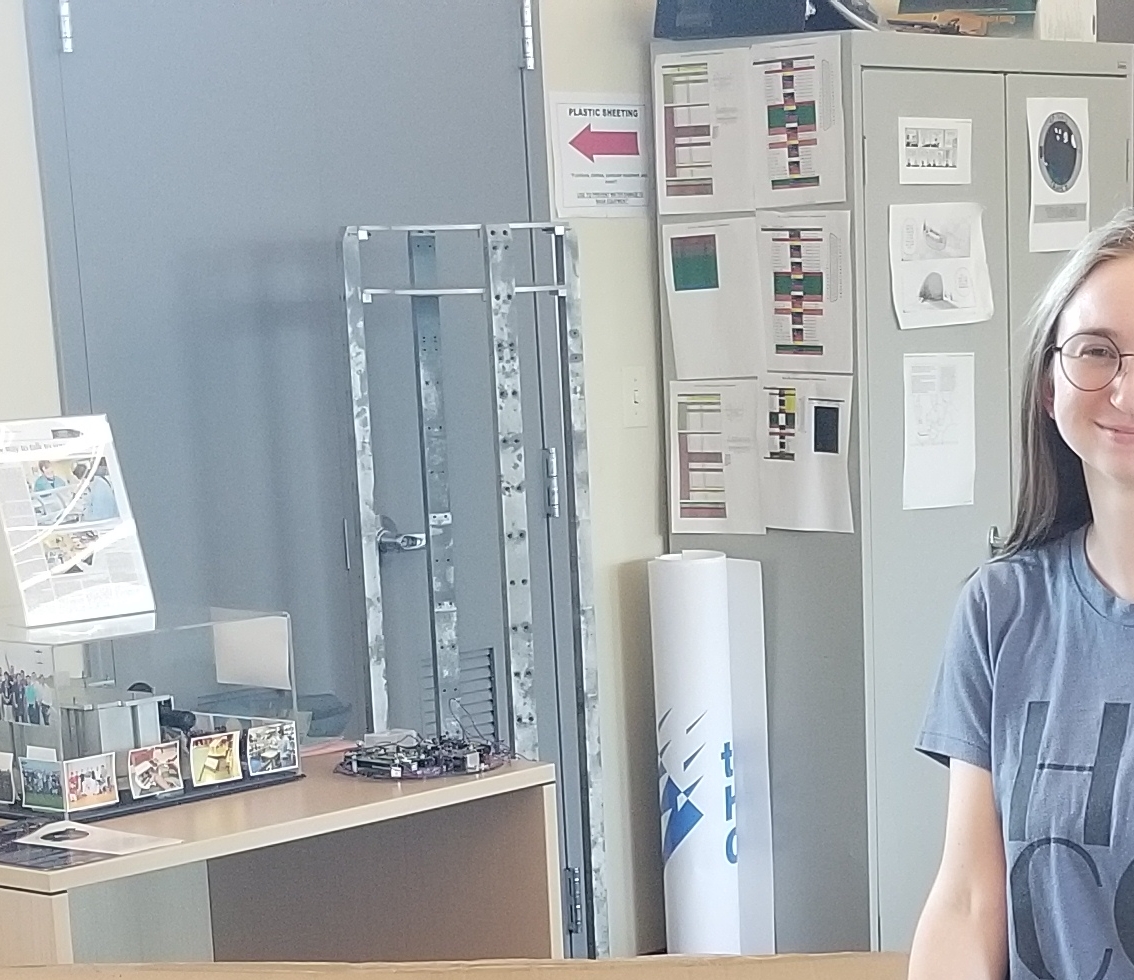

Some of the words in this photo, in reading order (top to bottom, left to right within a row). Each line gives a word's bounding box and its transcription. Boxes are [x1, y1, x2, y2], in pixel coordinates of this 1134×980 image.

[568, 108, 600, 116] PLASTIC
[602, 109, 639, 118] SHEETING
[1008, 701, 1131, 846] H
